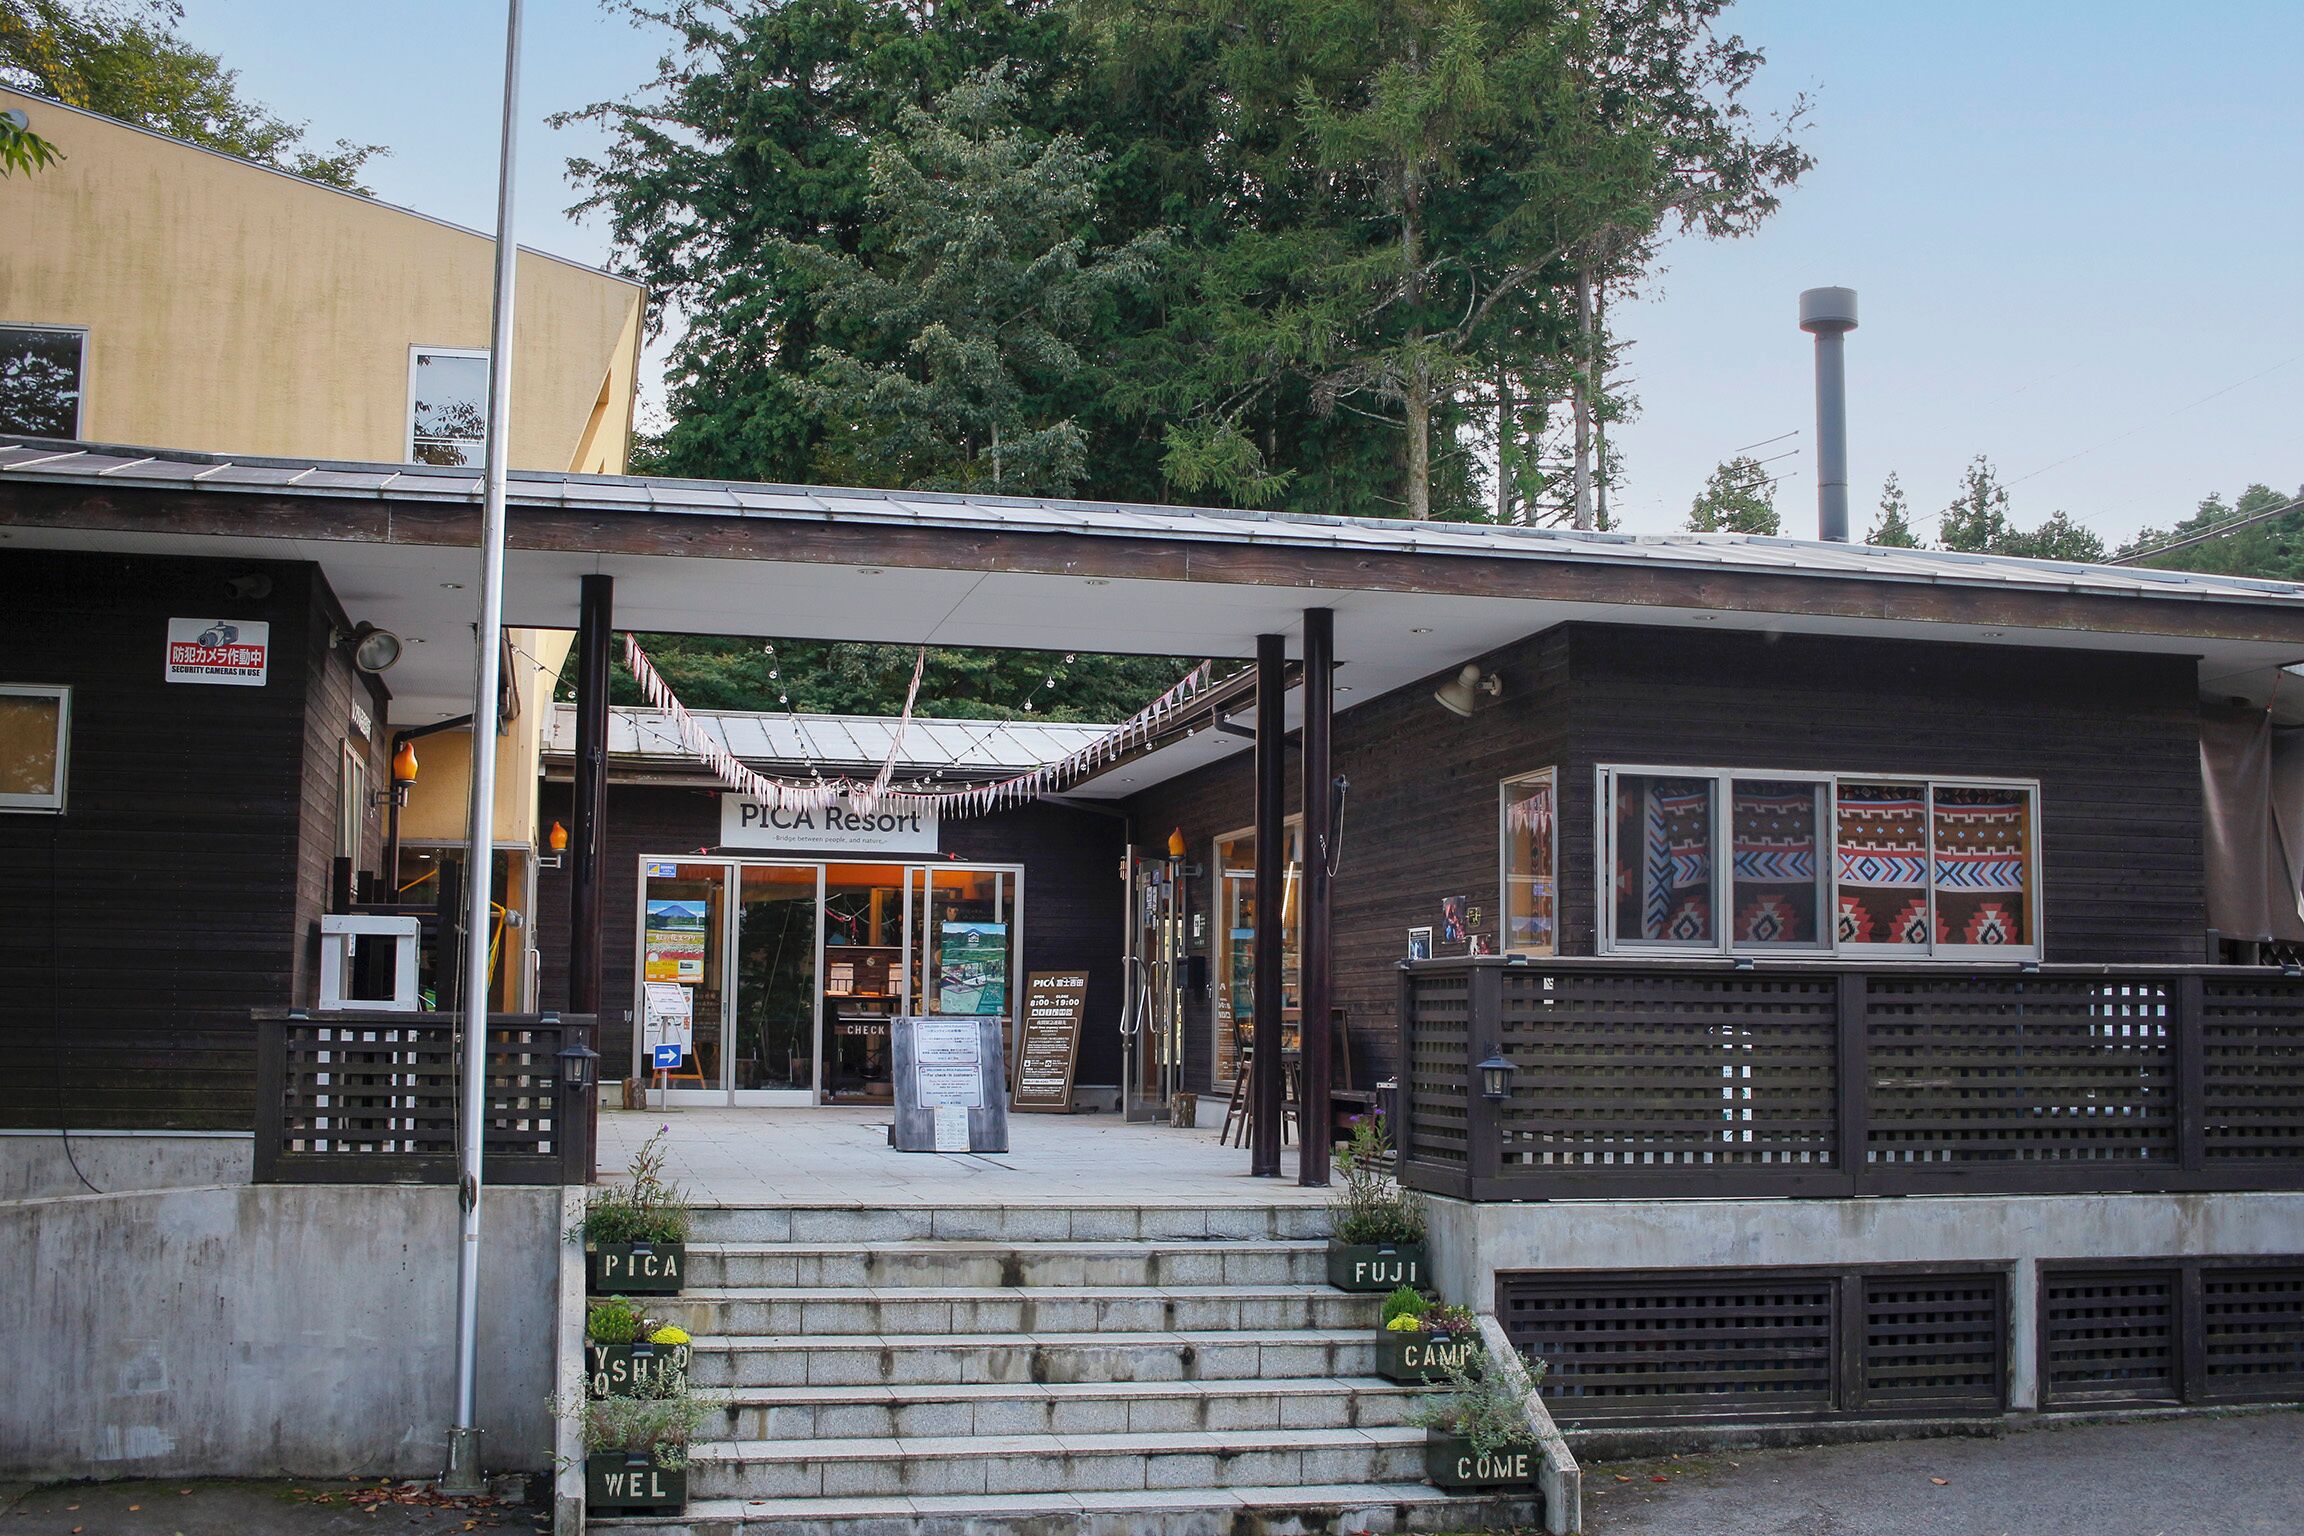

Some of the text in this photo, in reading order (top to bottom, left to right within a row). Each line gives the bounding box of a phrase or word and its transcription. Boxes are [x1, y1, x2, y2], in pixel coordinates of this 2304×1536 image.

[172, 646, 262, 666] 防犯カメラ作動中
[172, 665, 204, 674] SECURITY
[205, 667, 238, 676] CAMERAS
[247, 669, 260, 677] USE
[740, 803, 921, 833] PICA Resort
[797, 835, 823, 843] between
[847, 1025, 885, 1035] CHECK
[605, 1254, 678, 1277] PICA
[1355, 1261, 1416, 1283] FUJI
[1404, 1343, 1471, 1367] CAMP
[1457, 1454, 1528, 1479] COME
[604, 1471, 666, 1497] WEL
